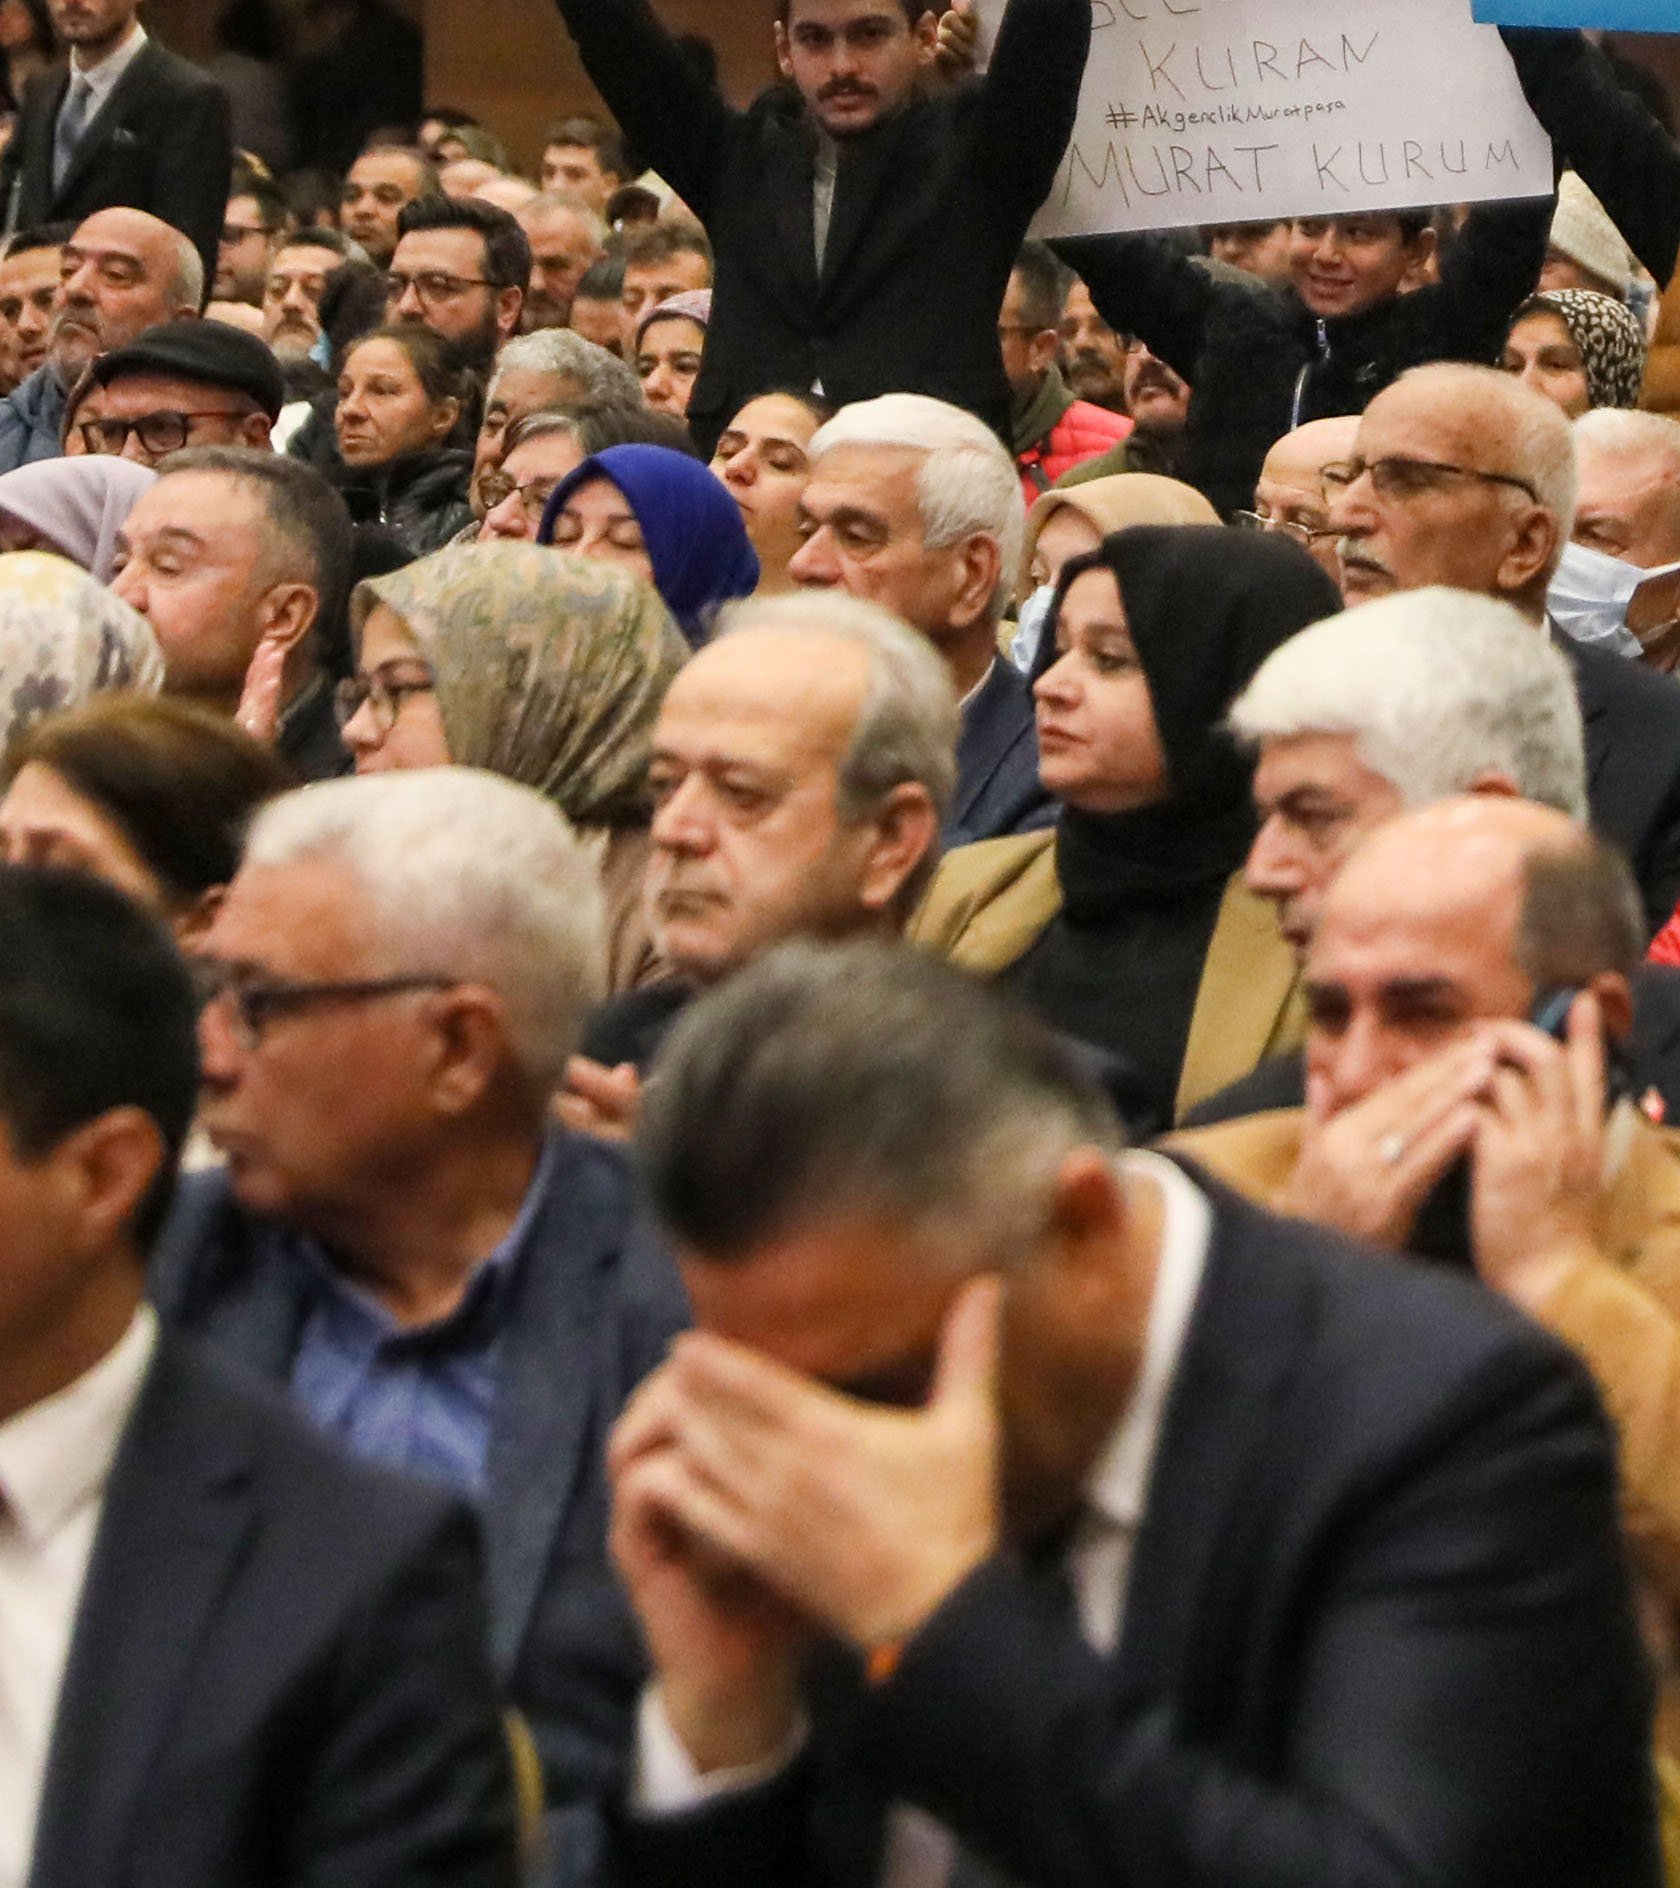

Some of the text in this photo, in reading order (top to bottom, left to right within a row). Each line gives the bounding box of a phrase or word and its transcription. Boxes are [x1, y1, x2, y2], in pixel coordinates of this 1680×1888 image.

[1138, 31, 1381, 101] KURAN
[1062, 138, 1520, 208] MURAT KURUM
